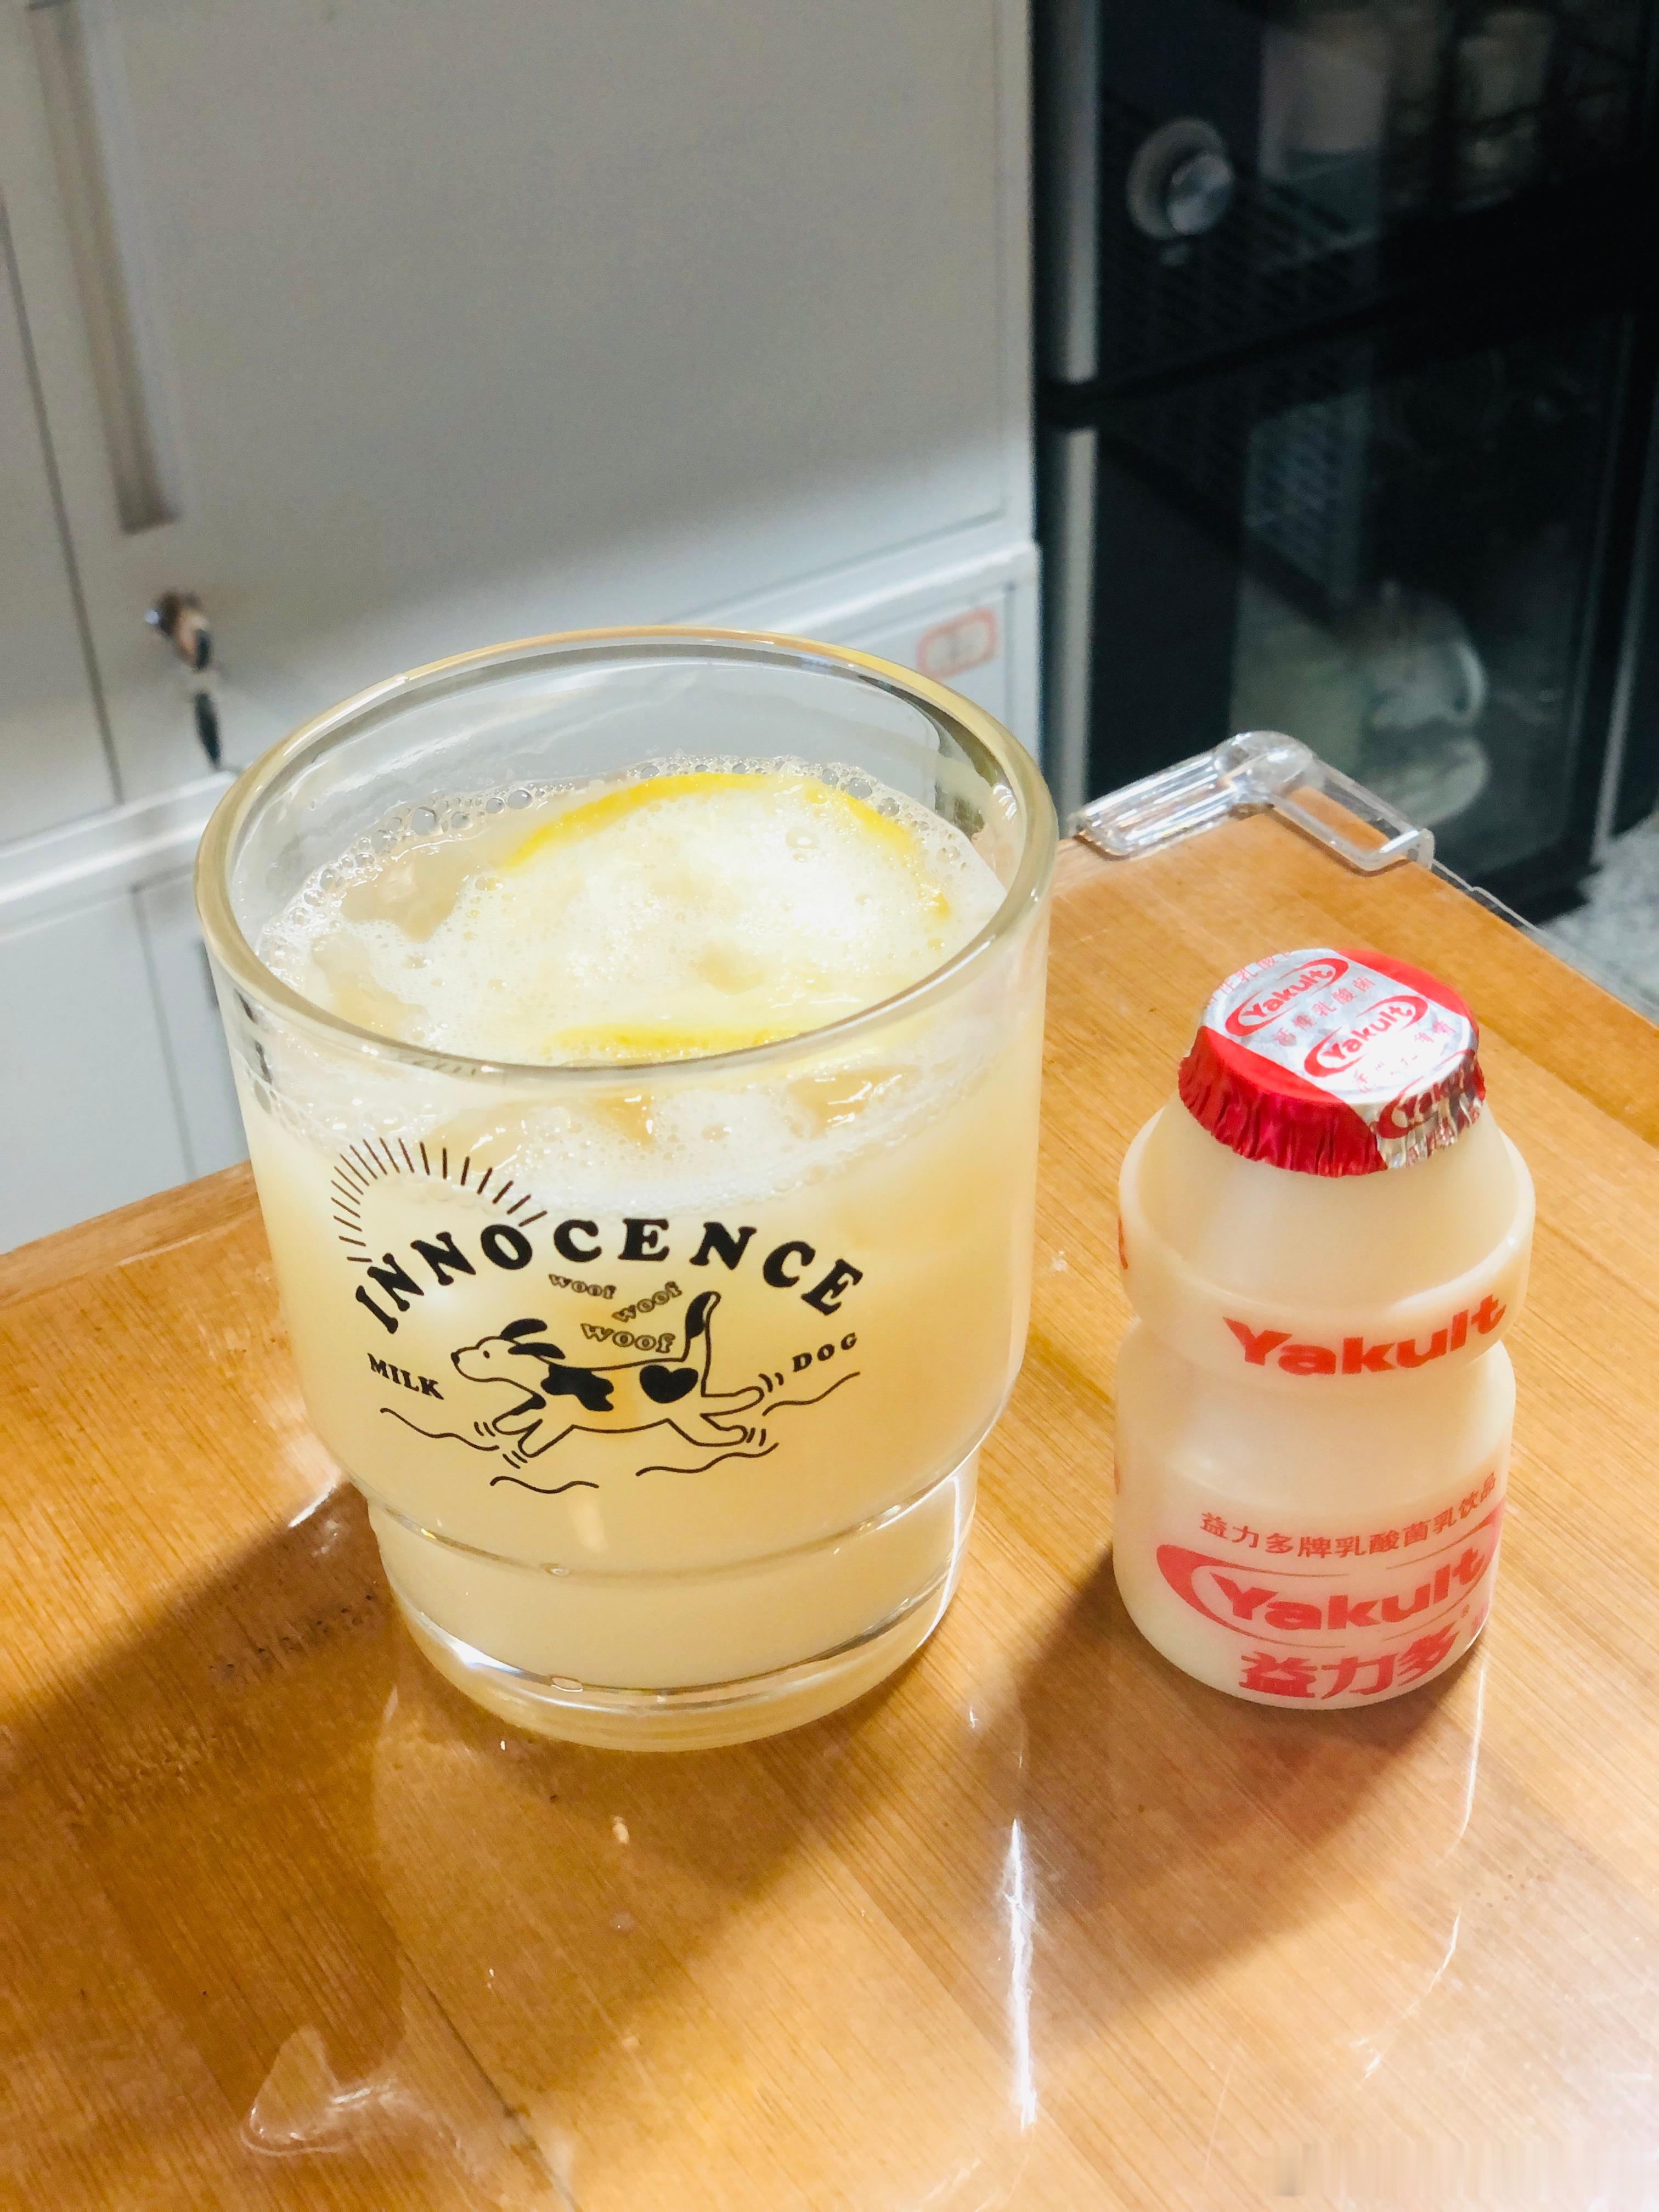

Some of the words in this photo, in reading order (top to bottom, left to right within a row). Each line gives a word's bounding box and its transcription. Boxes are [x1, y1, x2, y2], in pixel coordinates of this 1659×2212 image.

[1242, 970, 1333, 1018] Yakult
[1321, 1004, 1412, 1061] Yakult
[355, 1218, 864, 1334] INNOCENCE
[366, 1353, 444, 1400] MILK
[791, 1332, 859, 1373] DOG
[1222, 1293, 1507, 1376] Yakult
[1199, 1471, 1496, 1558] 益力多牌乳酸菌乳饮品
[1209, 1546, 1486, 1630] Yakult
[1238, 1620, 1460, 1700] 益力多
